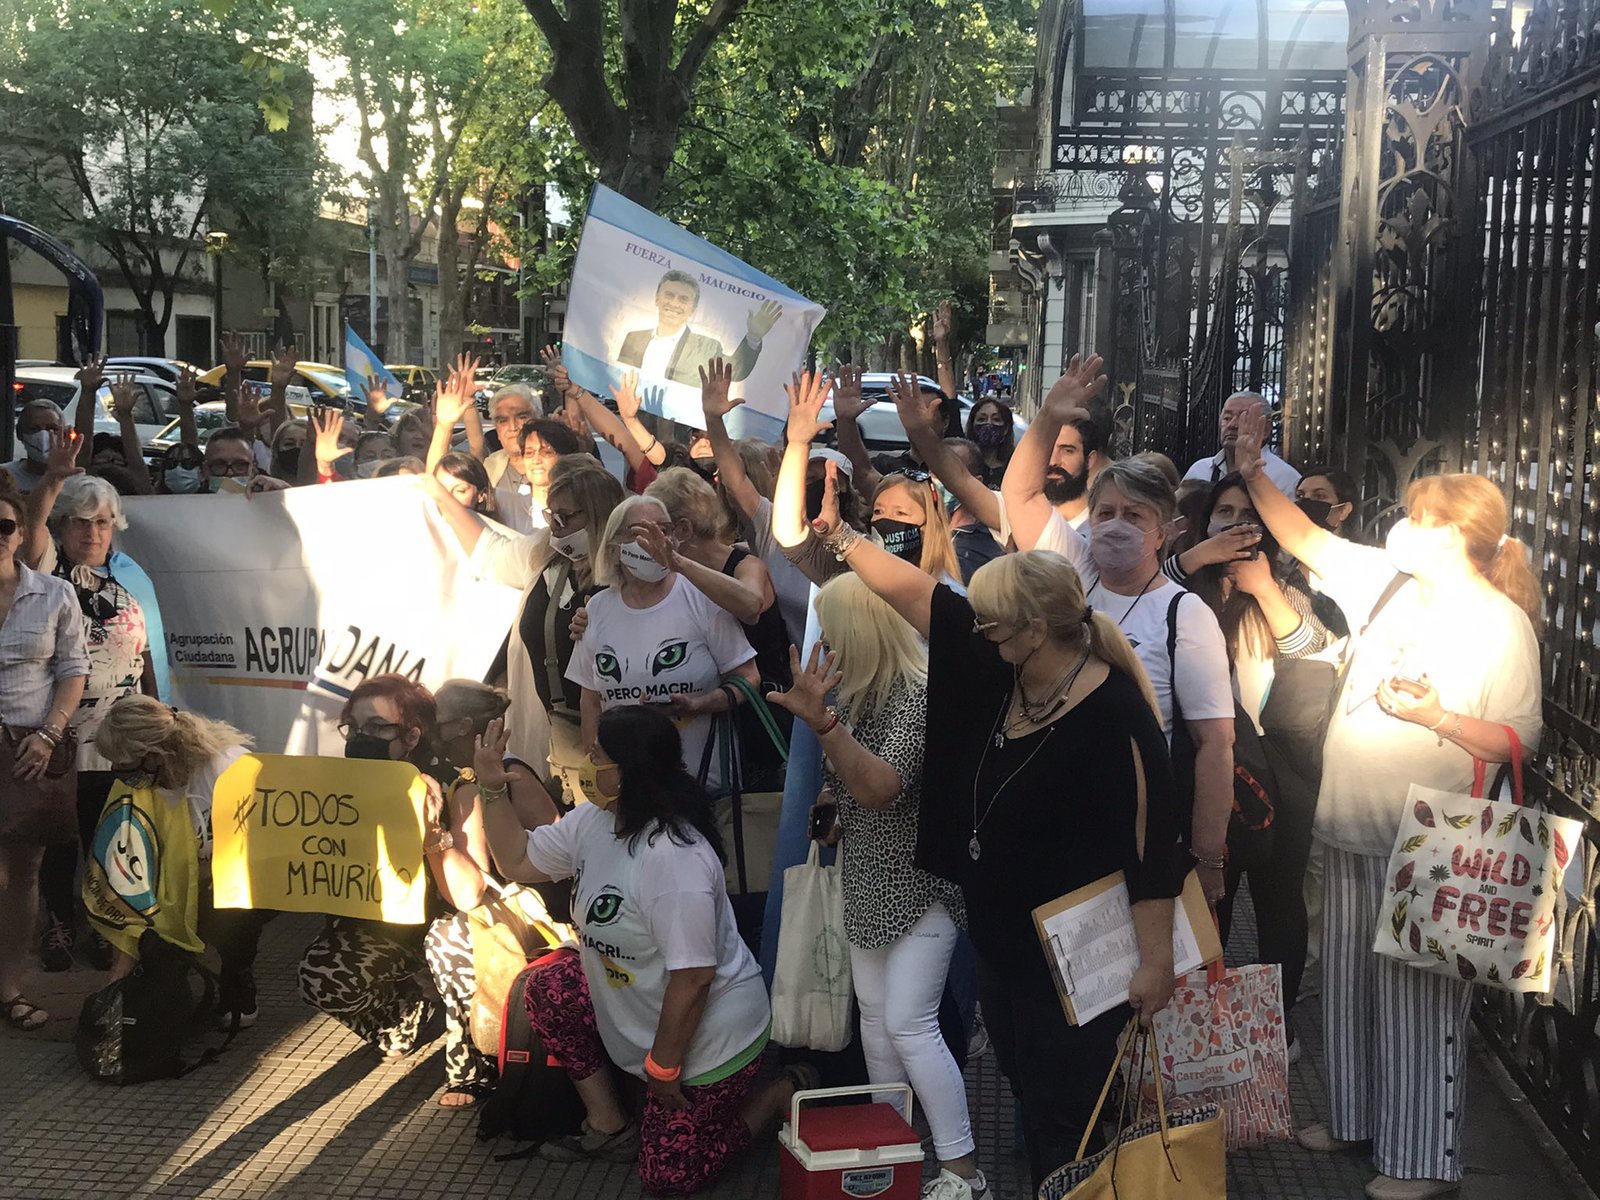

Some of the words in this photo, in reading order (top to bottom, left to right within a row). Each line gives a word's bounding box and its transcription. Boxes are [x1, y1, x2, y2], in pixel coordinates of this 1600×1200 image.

[625, 242, 672, 269] FUERZA
[699, 272, 766, 301] MAURICIO
[170, 632, 234, 647] Agrupación
[175, 650, 235, 662] Ciudadana
[234, 788, 360, 835] #TODOS
[302, 835, 346, 857] CON
[1478, 884, 1498, 896] AND
[1431, 885, 1533, 940] FREE
[1465, 933, 1496, 949] SPIRIT
